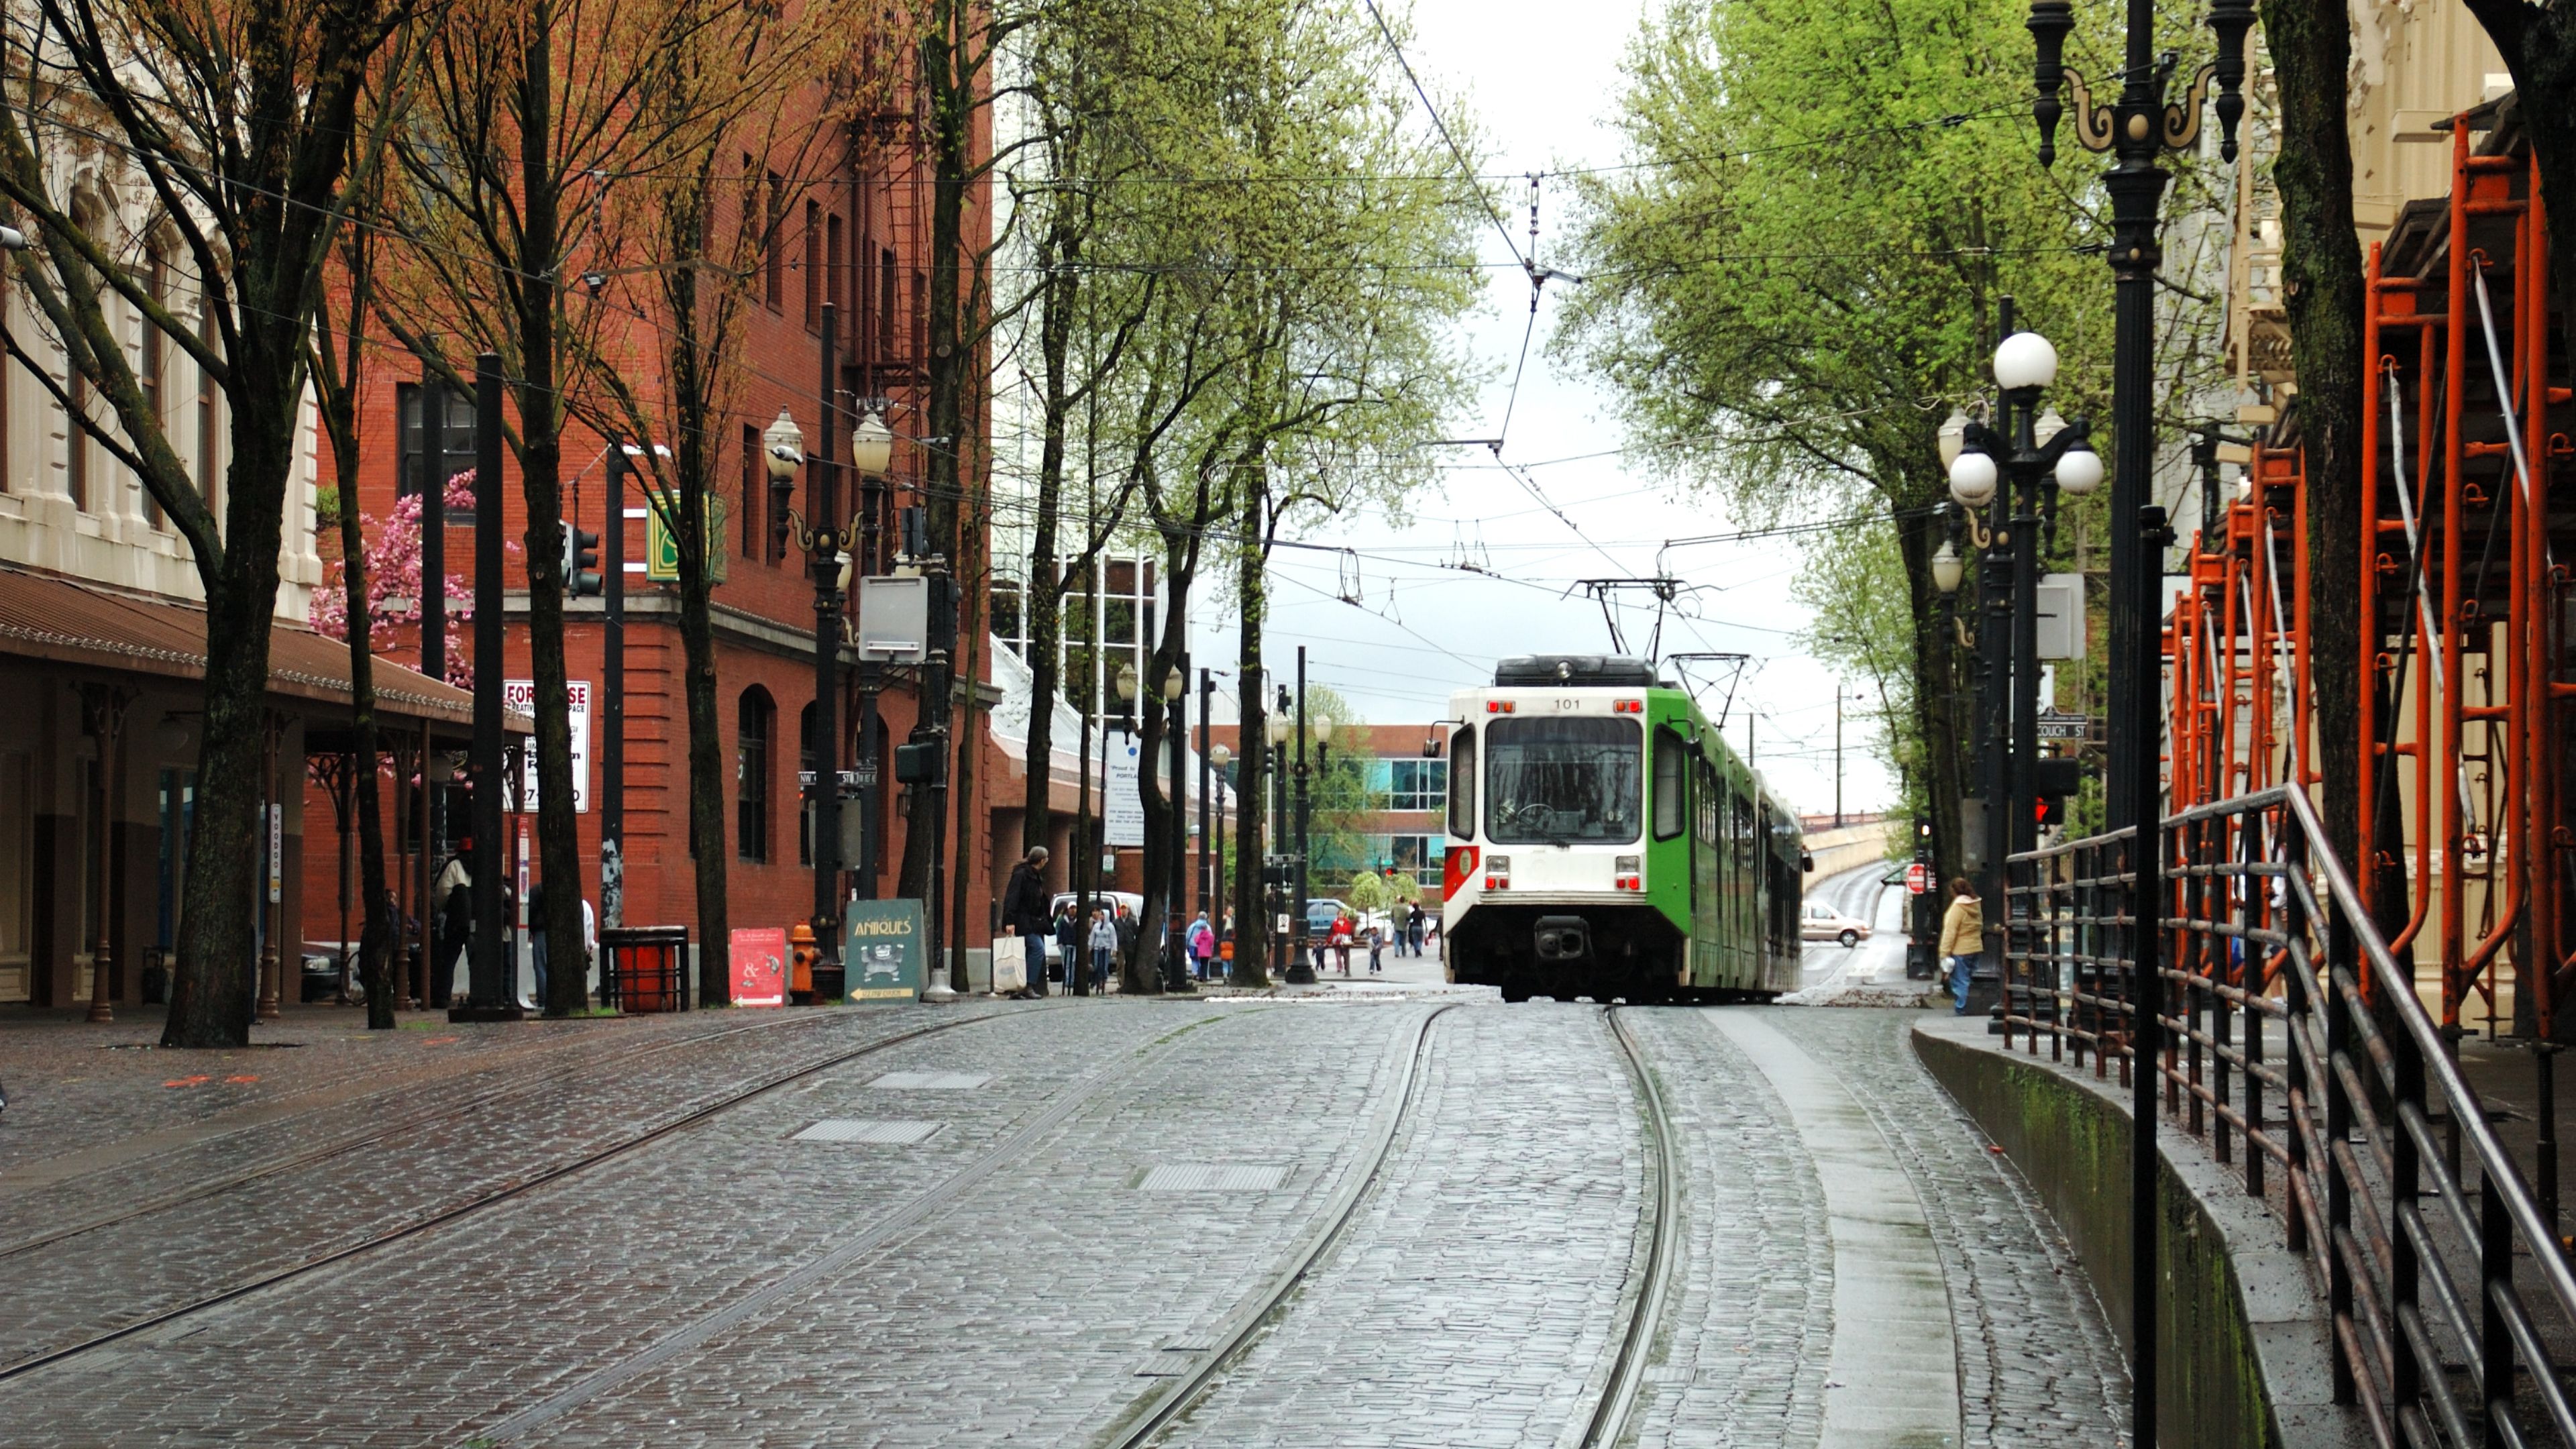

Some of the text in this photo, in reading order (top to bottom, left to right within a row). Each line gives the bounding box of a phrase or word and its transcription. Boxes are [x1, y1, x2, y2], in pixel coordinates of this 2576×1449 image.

[507, 685, 534, 703] FOR
[508, 704, 534, 712] REATIV
[1554, 698, 1580, 710] 101
[2037, 725, 2086, 737] COUCH ST
[800, 773, 812, 783] NW
[854, 920, 912, 936] ANTIQUES
[743, 962, 759, 977] &
